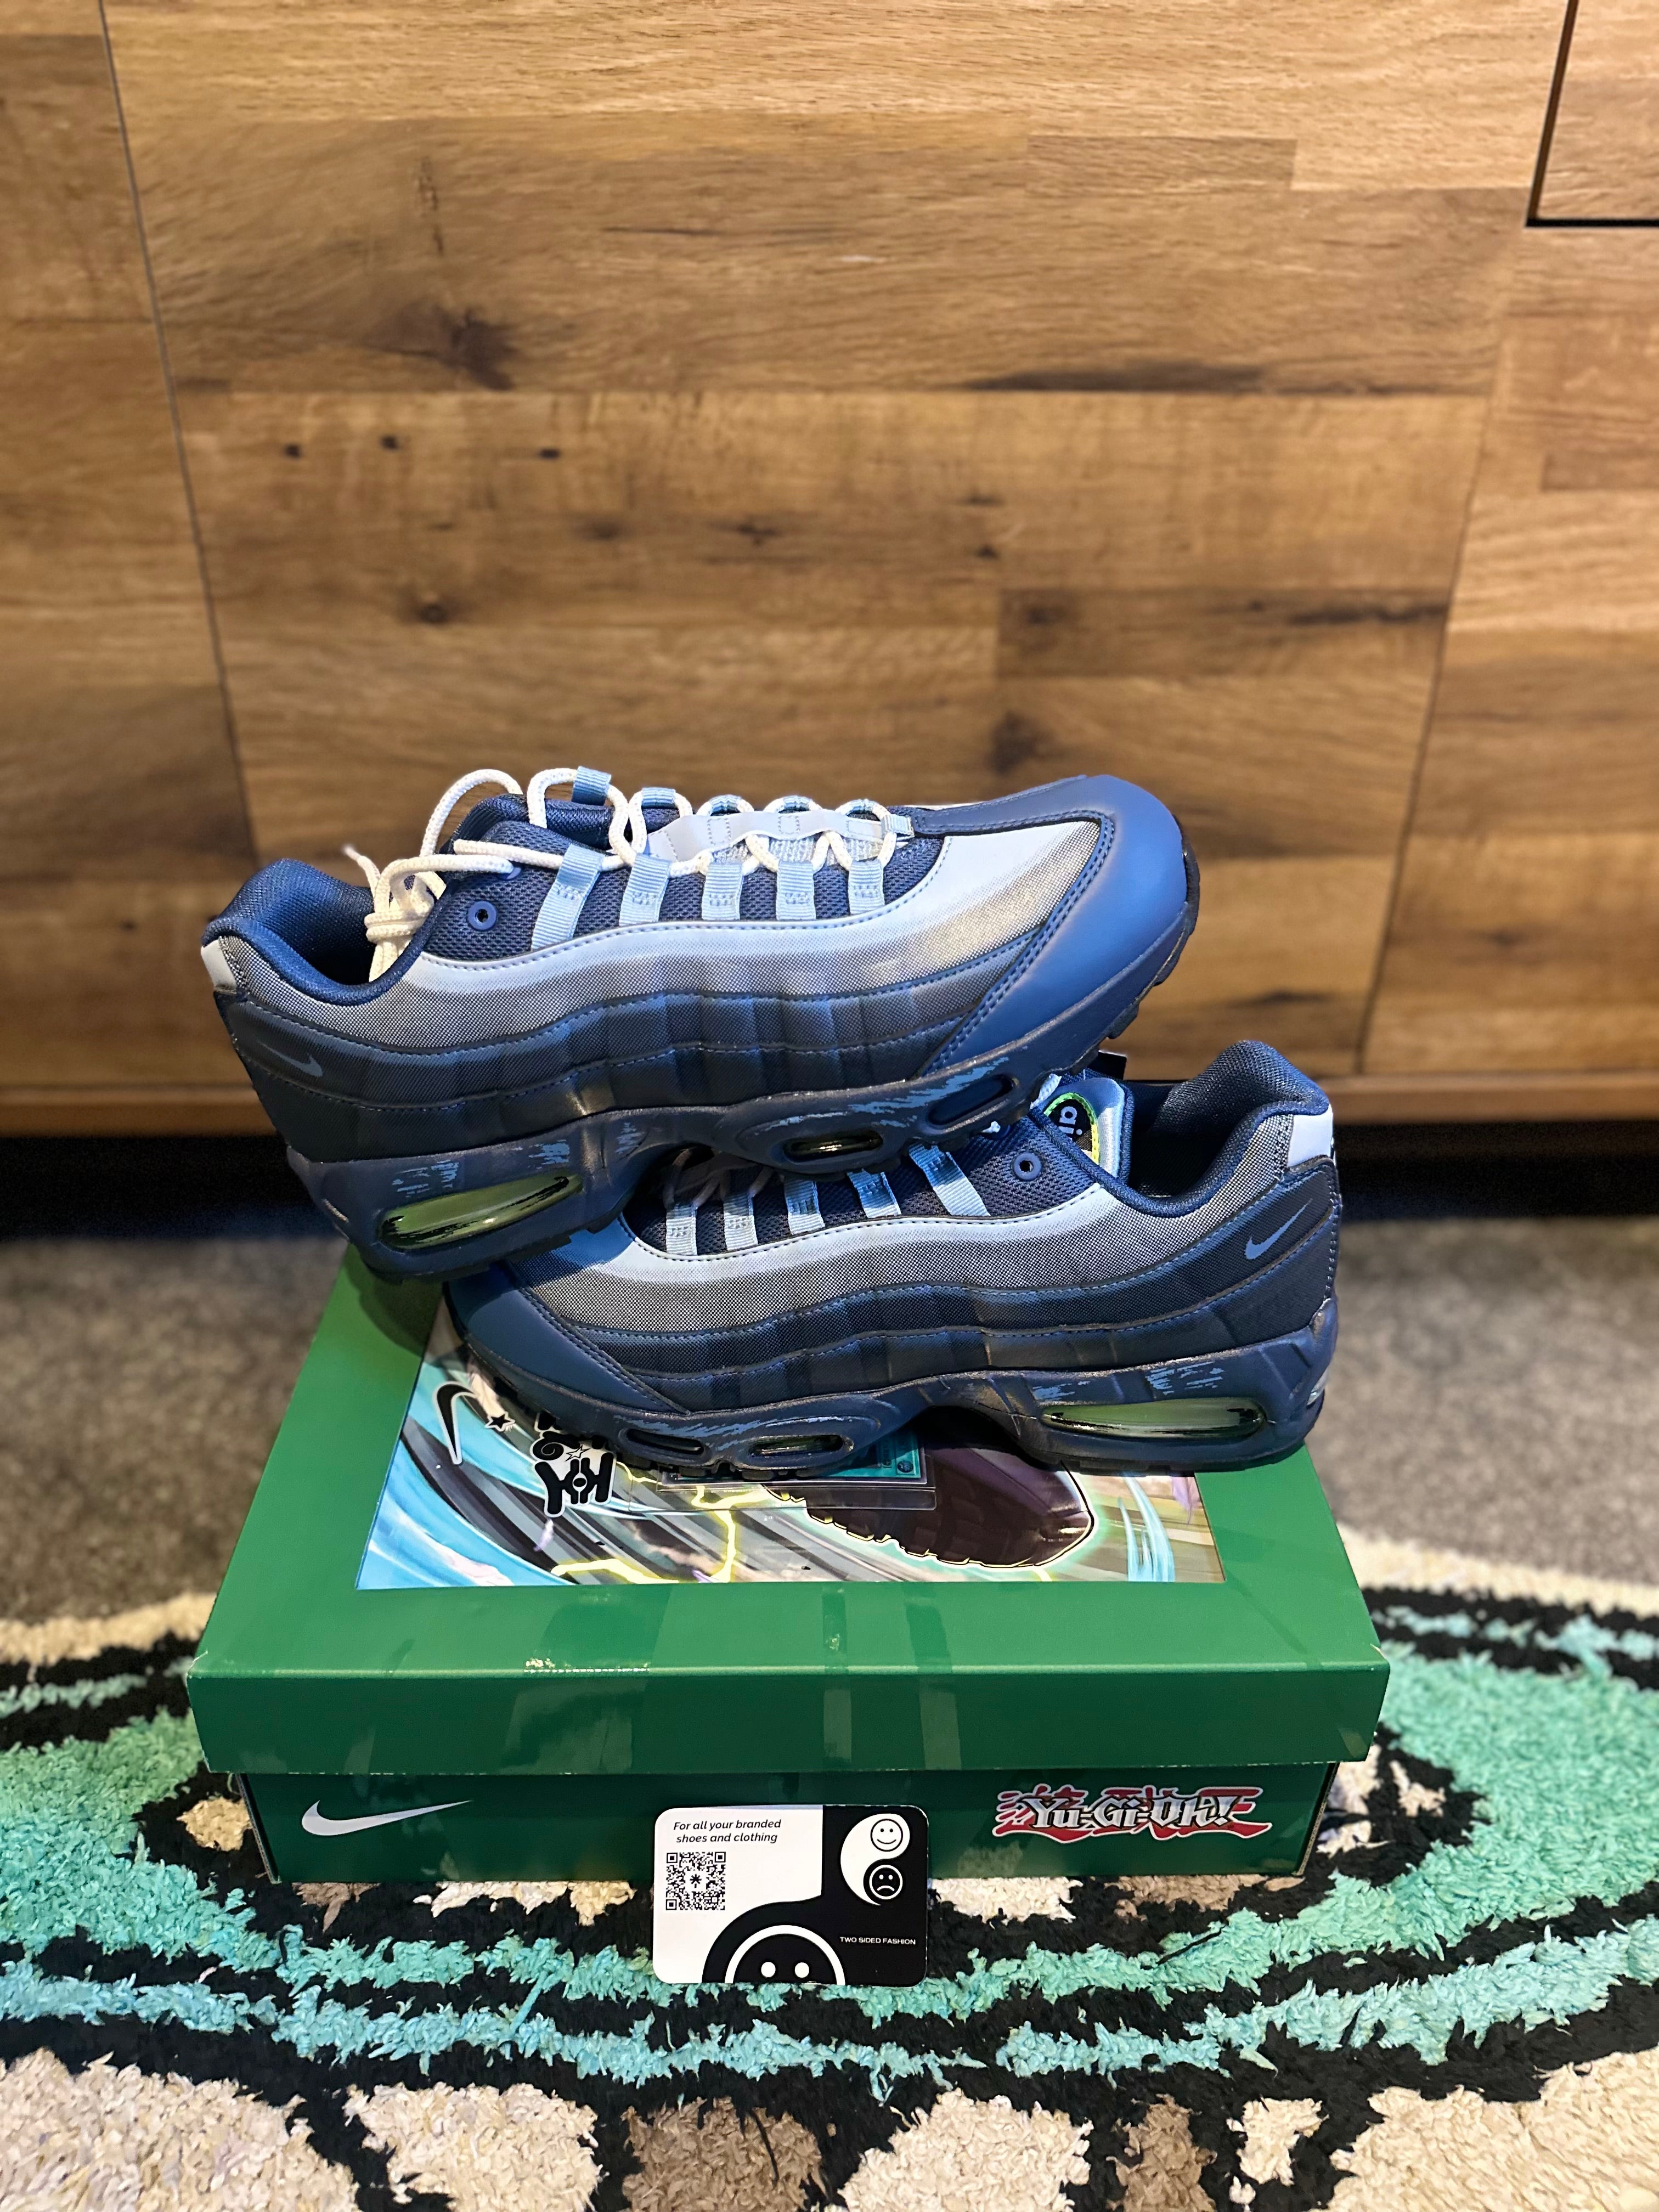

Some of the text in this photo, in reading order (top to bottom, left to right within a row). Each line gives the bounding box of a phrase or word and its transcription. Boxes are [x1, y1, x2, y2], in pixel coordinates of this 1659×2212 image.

[1058, 1106, 1082, 1141] ai
[1022, 1796, 1235, 1828] Yu-Gi-Oh!
[674, 1819, 781, 1831] For all your branded
[676, 1832, 777, 1843] shoes and clothing
